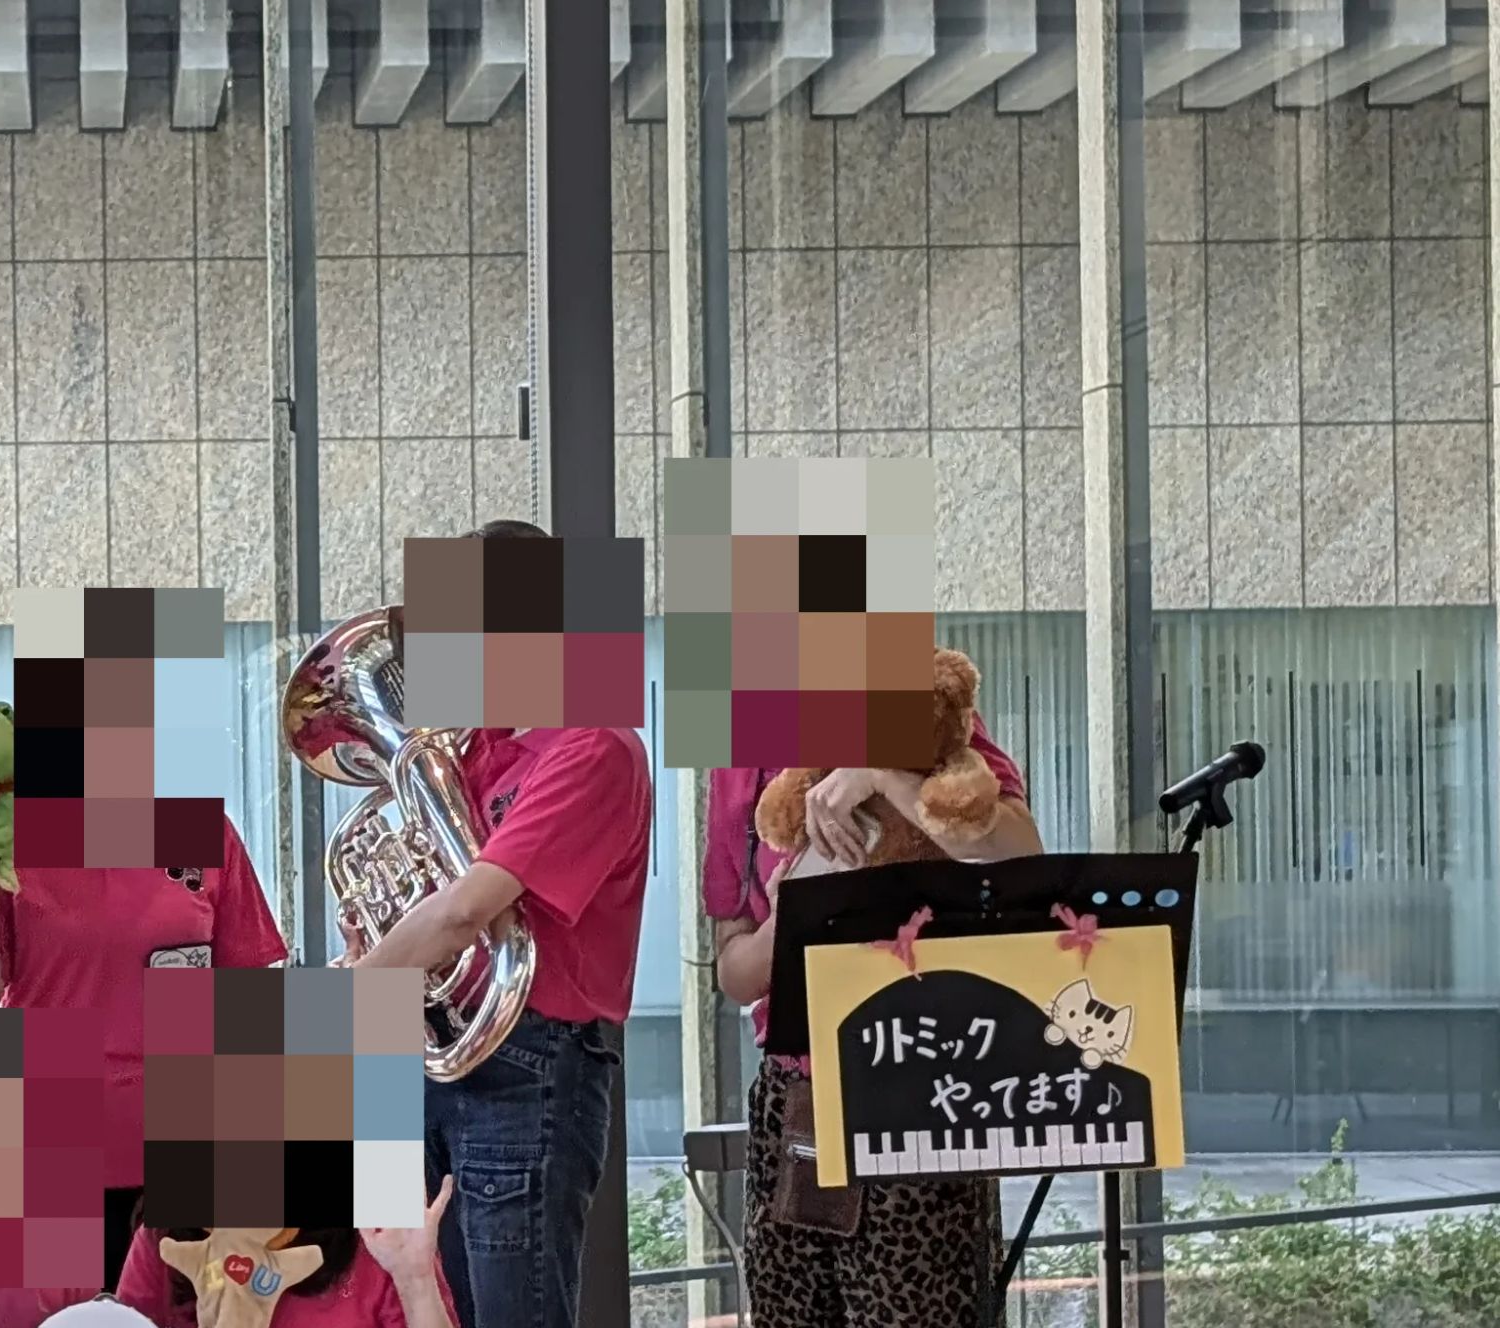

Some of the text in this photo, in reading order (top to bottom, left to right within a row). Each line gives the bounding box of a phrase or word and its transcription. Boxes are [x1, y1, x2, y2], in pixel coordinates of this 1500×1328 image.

[861, 1016, 997, 1067] リトミック
[251, 1264, 282, 1297] U
